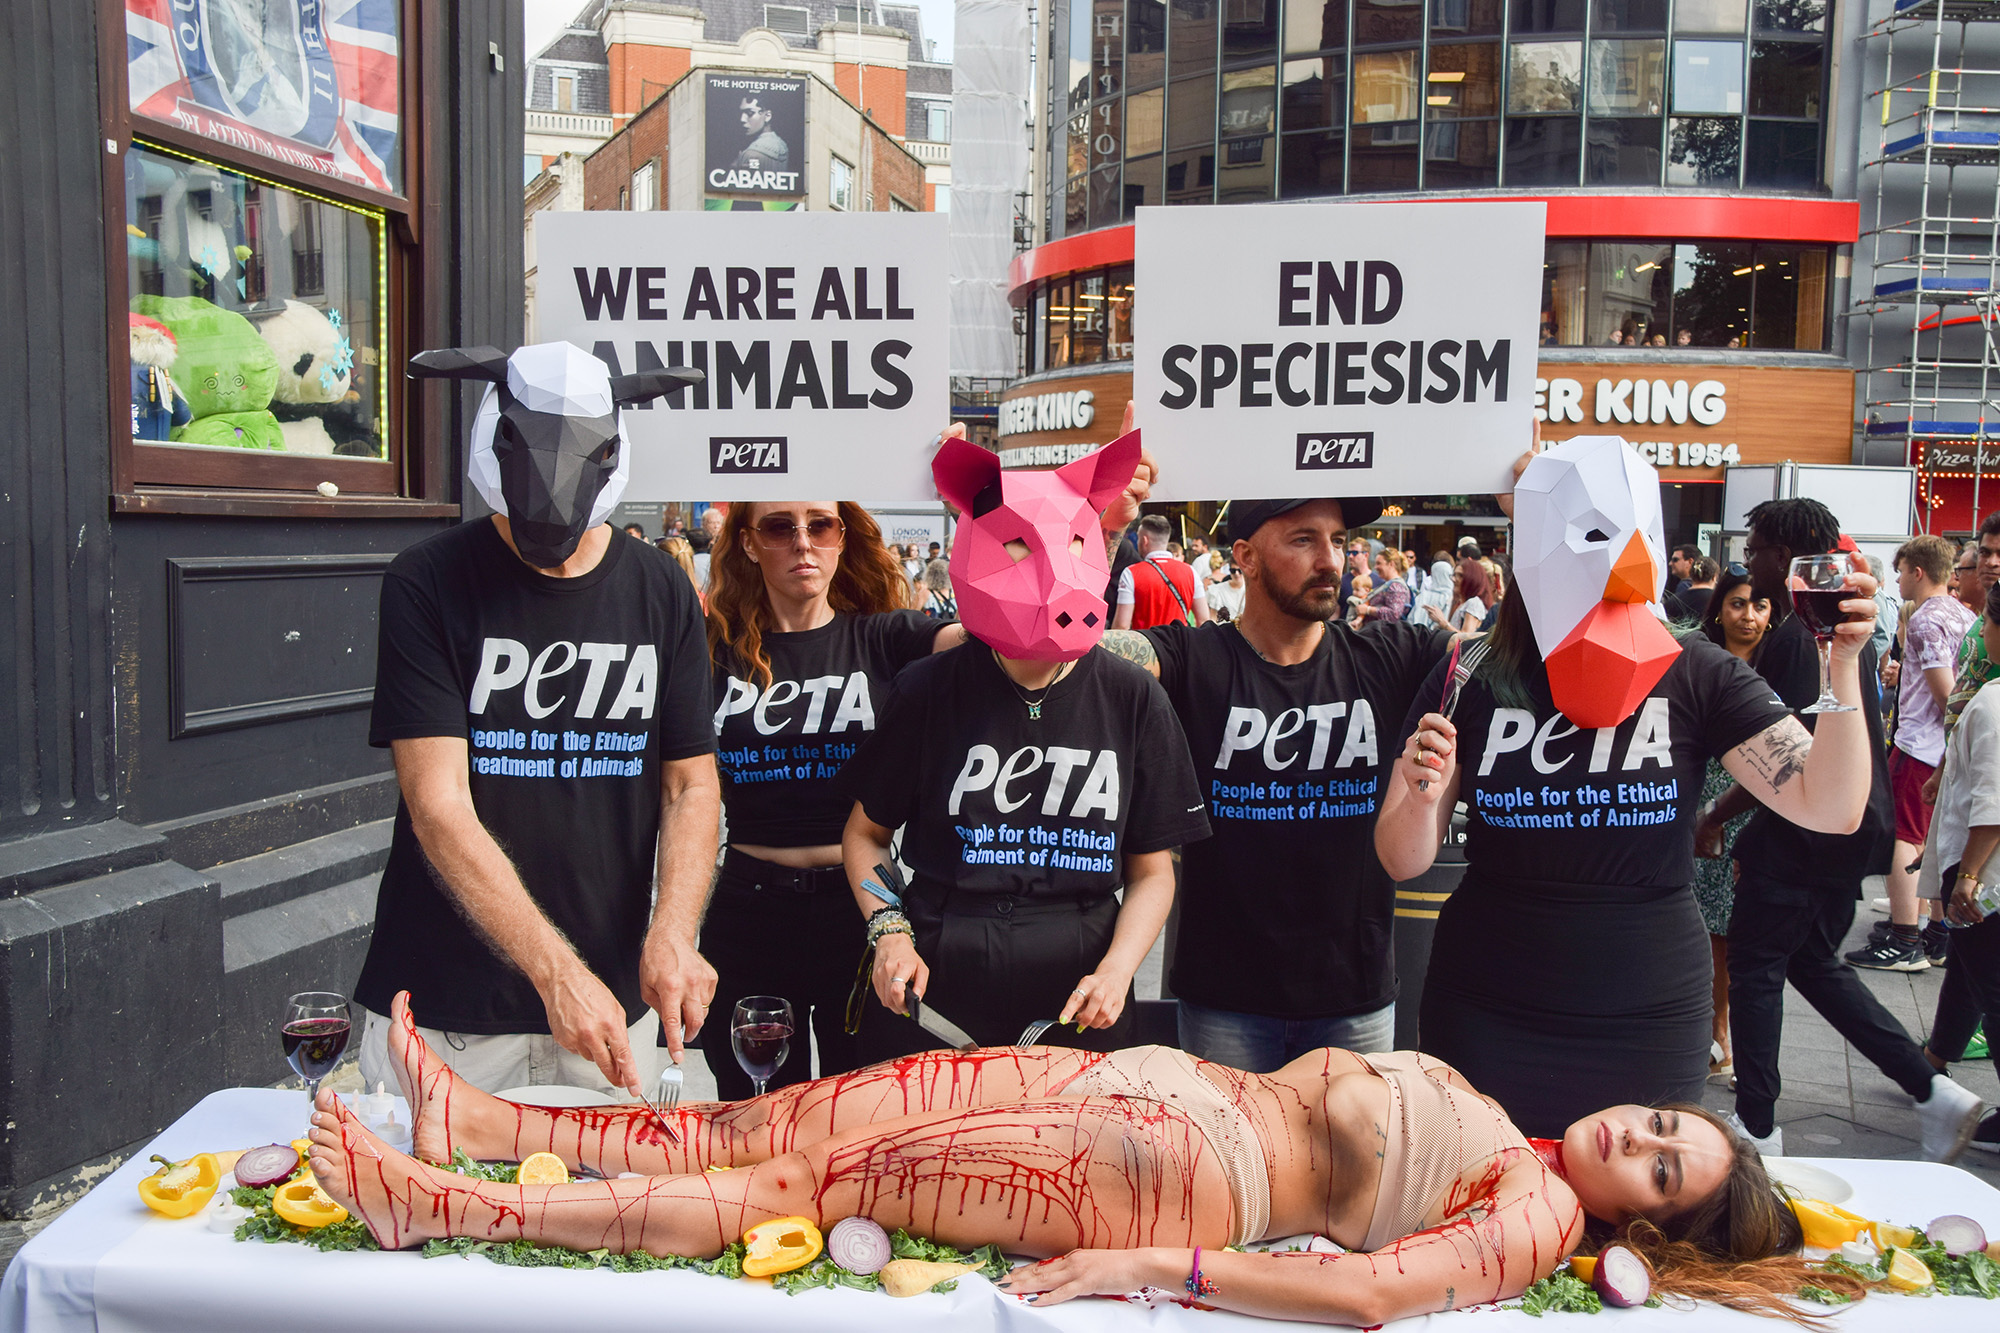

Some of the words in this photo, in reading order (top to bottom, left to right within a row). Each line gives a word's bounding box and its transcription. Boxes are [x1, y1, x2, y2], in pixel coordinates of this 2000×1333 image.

[731, 80, 769, 90] HOTTEST
[709, 168, 799, 191] CABARET
[573, 267, 668, 321] WE
[682, 267, 796, 321] ARE
[811, 267, 914, 321] ALL
[1278, 260, 1404, 327] END
[1159, 338, 1511, 410] SPECIESISM
[1036, 389, 1094, 431] KING
[1595, 378, 1727, 426] KING
[1677, 441, 1742, 467] 1954
[1925, 448, 1971, 467] Pizza
[892, 528, 931, 536] LONDON
[470, 727, 526, 751] eople
[531, 729, 558, 750] for
[563, 730, 591, 751] the
[594, 731, 648, 752] Ethical
[471, 753, 556, 778] reatment
[560, 757, 579, 778] of
[580, 756, 643, 778] Animals
[763, 745, 787, 762] for
[793, 744, 819, 759] the
[795, 761, 813, 779] of
[1211, 779, 1265, 803] People
[1269, 781, 1293, 799] for
[1297, 781, 1324, 798] the
[1328, 775, 1377, 798] Ethical
[1475, 786, 1534, 812] People
[1540, 786, 1570, 807] for
[1576, 785, 1611, 805] the
[1617, 778, 1678, 804] Ethical
[1211, 800, 1295, 821] Treatment
[1298, 801, 1315, 820] of
[1319, 797, 1375, 819] Animals
[1479, 810, 1574, 829] Treatment
[1580, 808, 1600, 828] of
[1606, 804, 1677, 827] Animals
[998, 824, 1024, 844] for
[1028, 825, 1058, 846] the
[1062, 828, 1116, 850] Ethical
[1030, 848, 1048, 867] of
[1050, 850, 1114, 873] Animals
